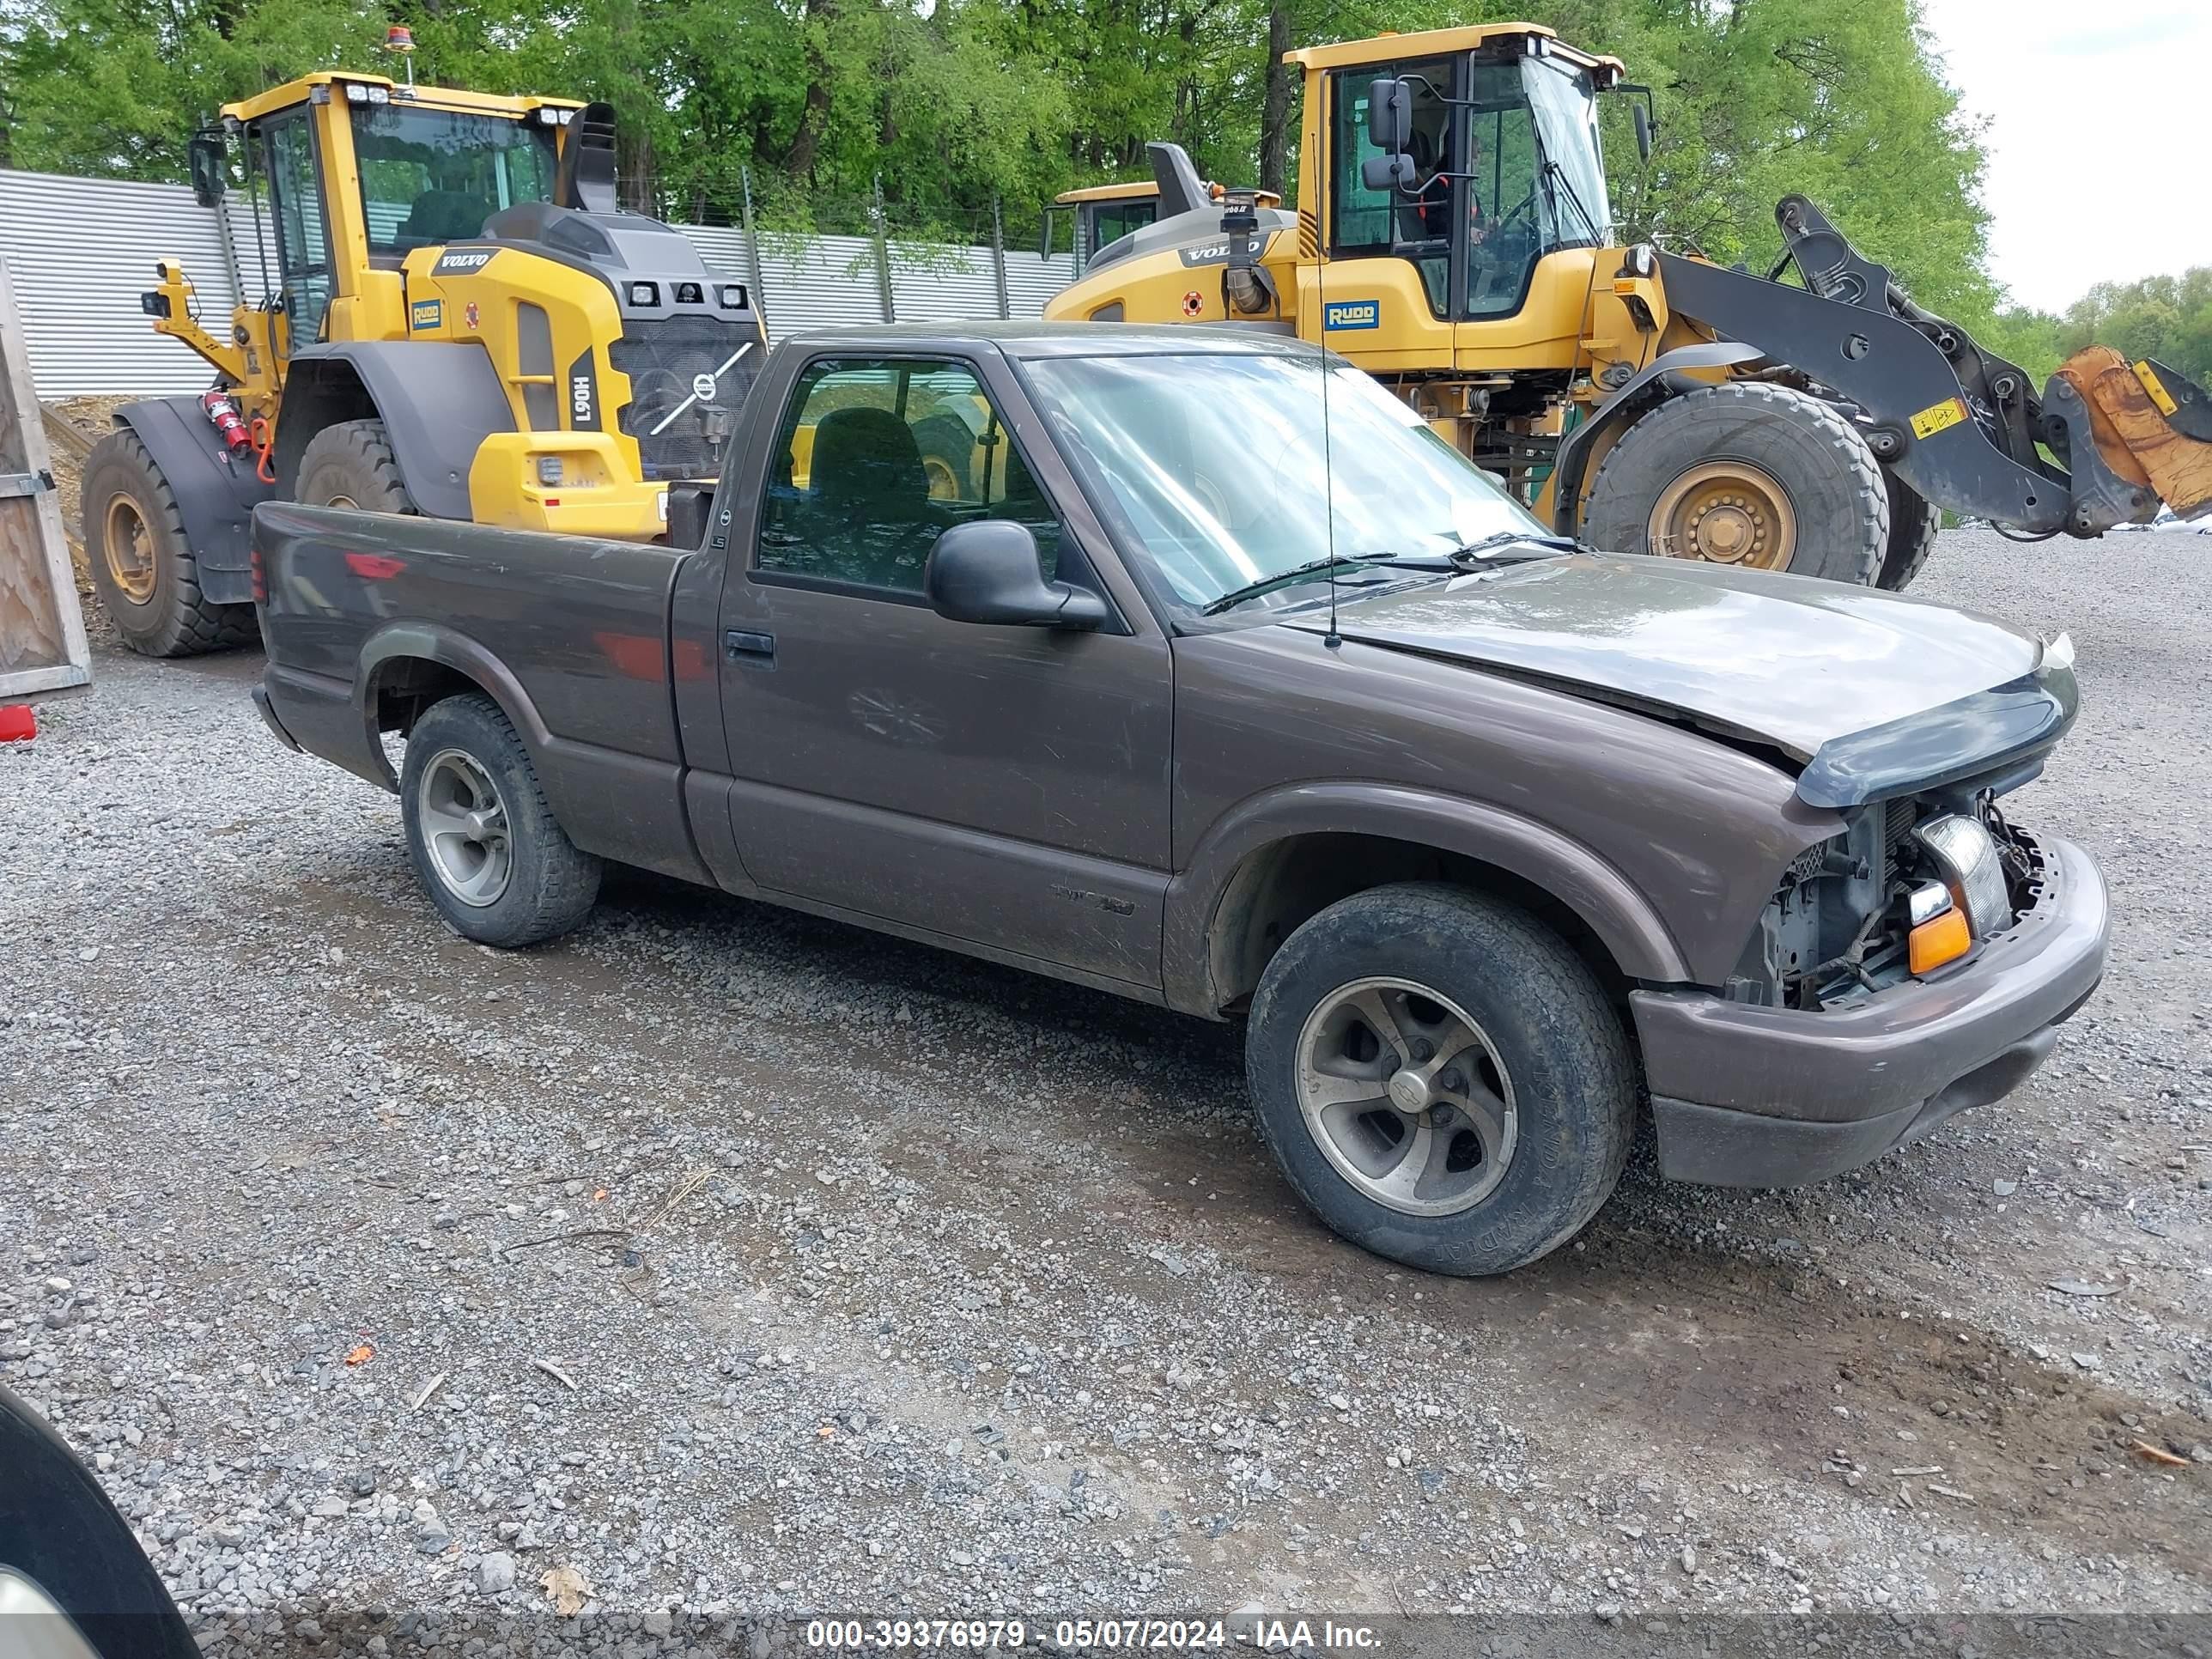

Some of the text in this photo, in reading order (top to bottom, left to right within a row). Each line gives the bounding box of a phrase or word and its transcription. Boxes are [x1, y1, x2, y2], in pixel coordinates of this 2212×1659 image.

[441, 253, 489, 267] VOLVO
[1188, 241, 1260, 261] VOLO
[414, 306, 439, 325] RUDD
[1328, 307, 1375, 325] RUDD
[574, 376, 591, 421] L90H
[711, 538, 725, 548] LS
[1427, 1202, 1535, 1262] RADIAL
